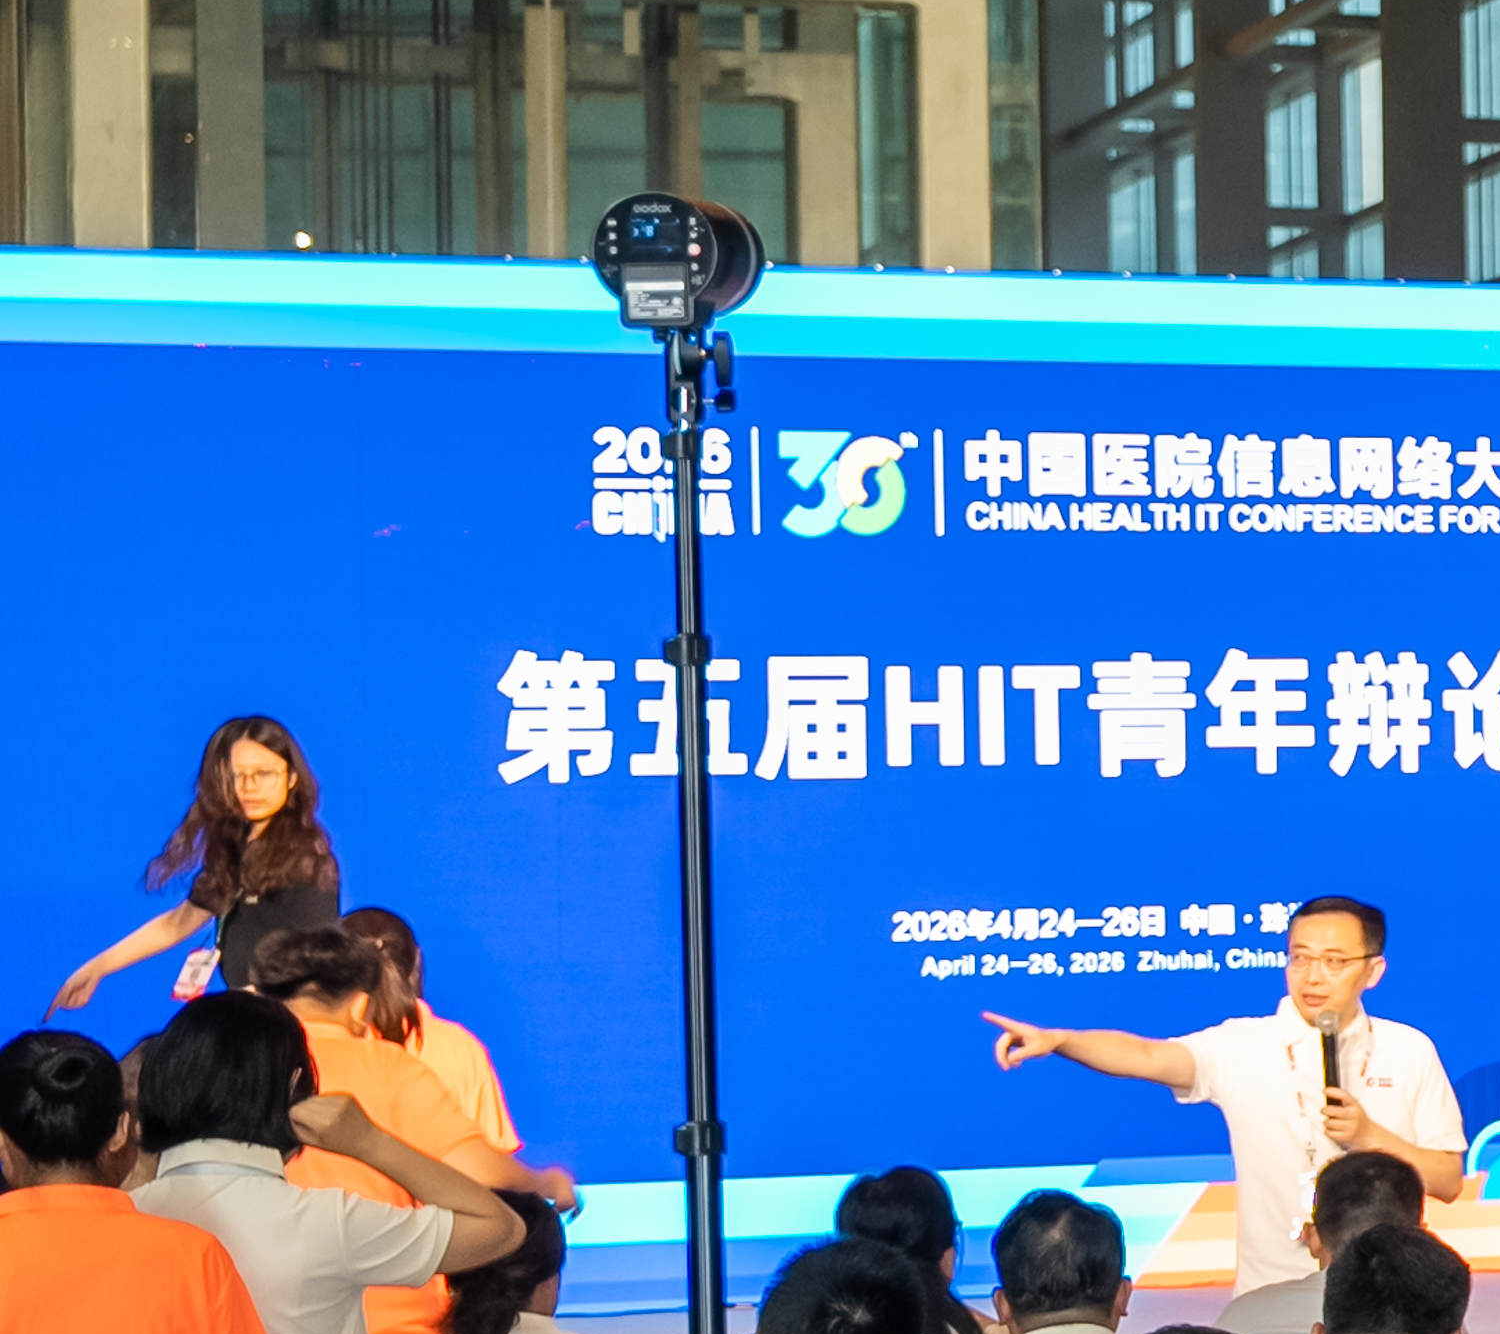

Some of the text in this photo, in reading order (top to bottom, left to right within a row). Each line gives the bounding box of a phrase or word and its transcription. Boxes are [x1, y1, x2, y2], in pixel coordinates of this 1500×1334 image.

[592, 425, 732, 475] 206
[965, 501, 1067, 532] CHINA
[1069, 502, 1191, 533] HEALTH
[1196, 503, 1225, 533] IT
[1228, 502, 1435, 534] CONFERENCE
[921, 955, 976, 980] April
[1070, 950, 1126, 974] 2026
[1137, 949, 1221, 973] Zhuhai,
